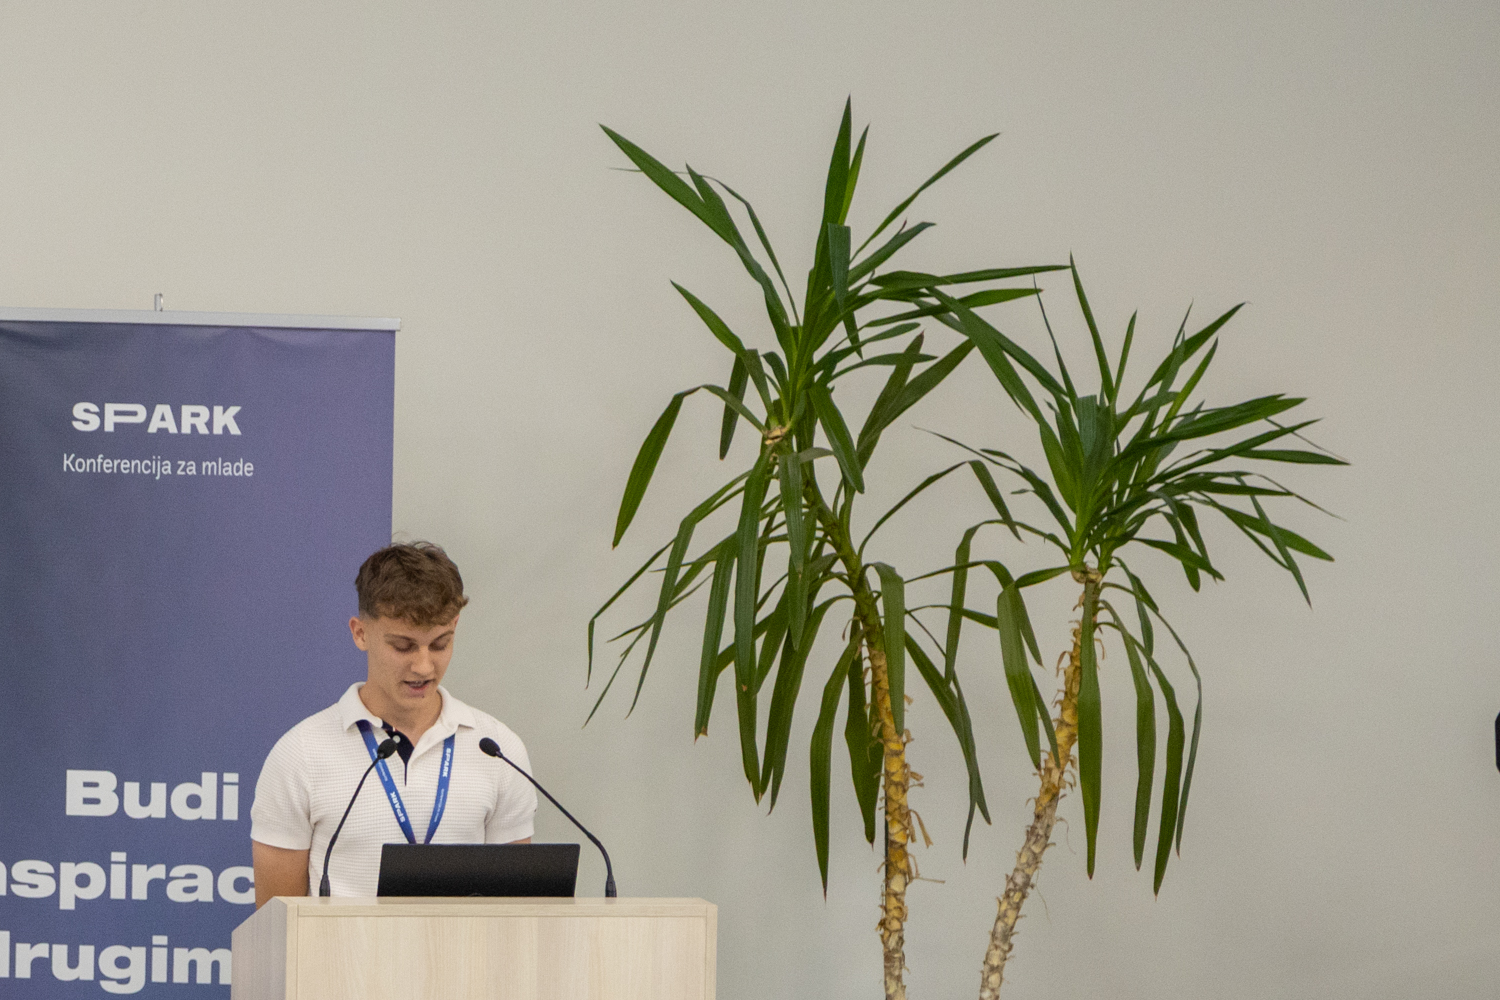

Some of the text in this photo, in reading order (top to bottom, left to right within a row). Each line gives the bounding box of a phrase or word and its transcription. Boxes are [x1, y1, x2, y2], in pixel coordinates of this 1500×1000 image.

[71, 401, 242, 436] SPARK
[63, 453, 255, 480] Konferencija za mlade
[442, 747, 452, 778] SPARK
[66, 769, 239, 821] Budi
[390, 791, 406, 823] SPARK
